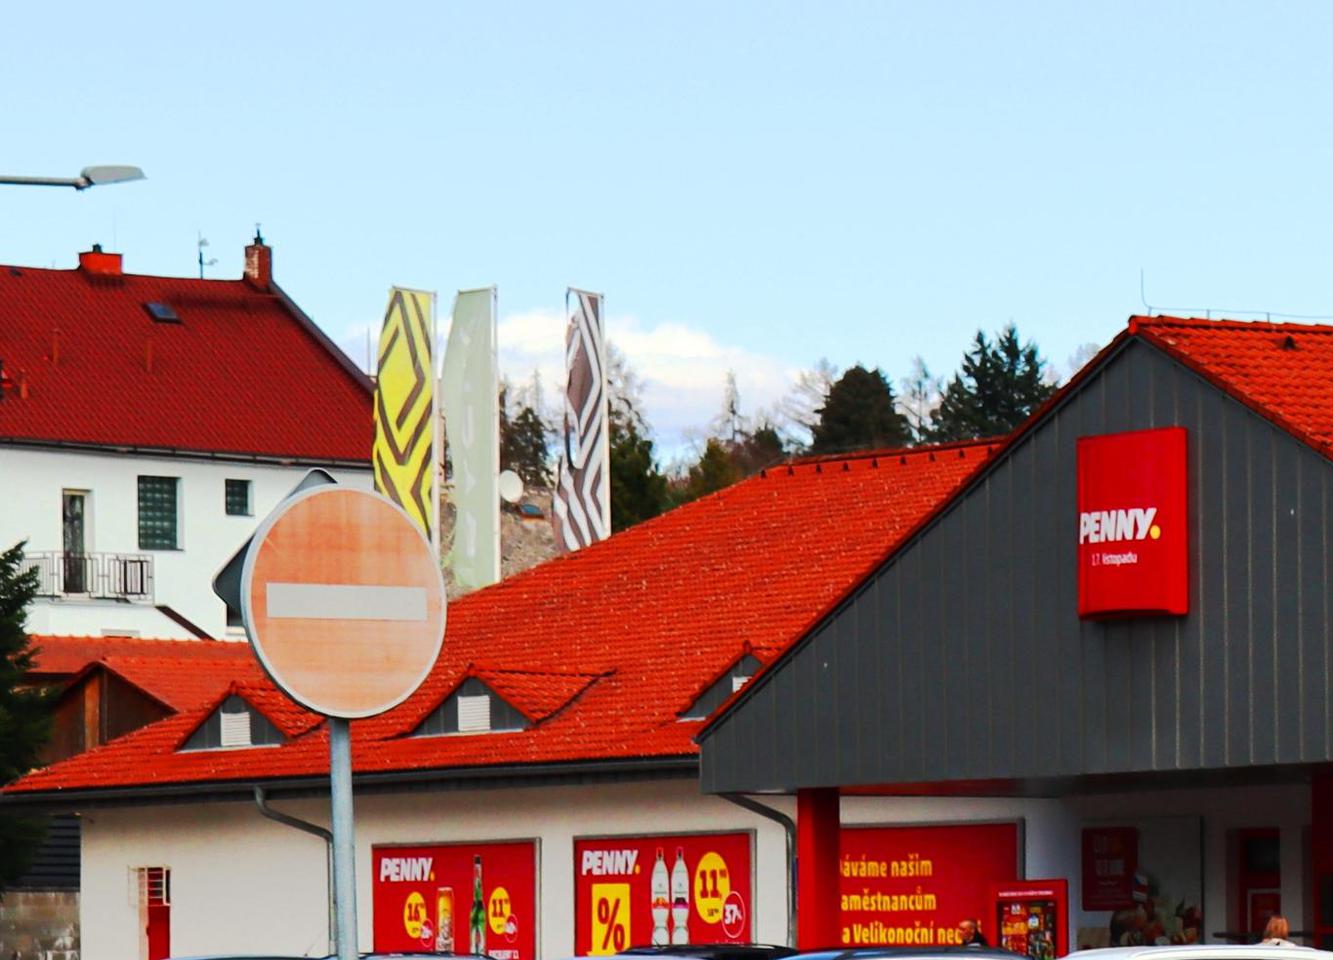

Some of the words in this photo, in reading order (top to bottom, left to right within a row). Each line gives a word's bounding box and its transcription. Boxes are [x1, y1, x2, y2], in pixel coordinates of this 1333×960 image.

[1080, 508, 1161, 545] PENNY.
[380, 857, 435, 882] PENNY.
[581, 849, 641, 876] PENNY.
[840, 854, 887, 878] áváme
[853, 921, 934, 944] Velikonoční
